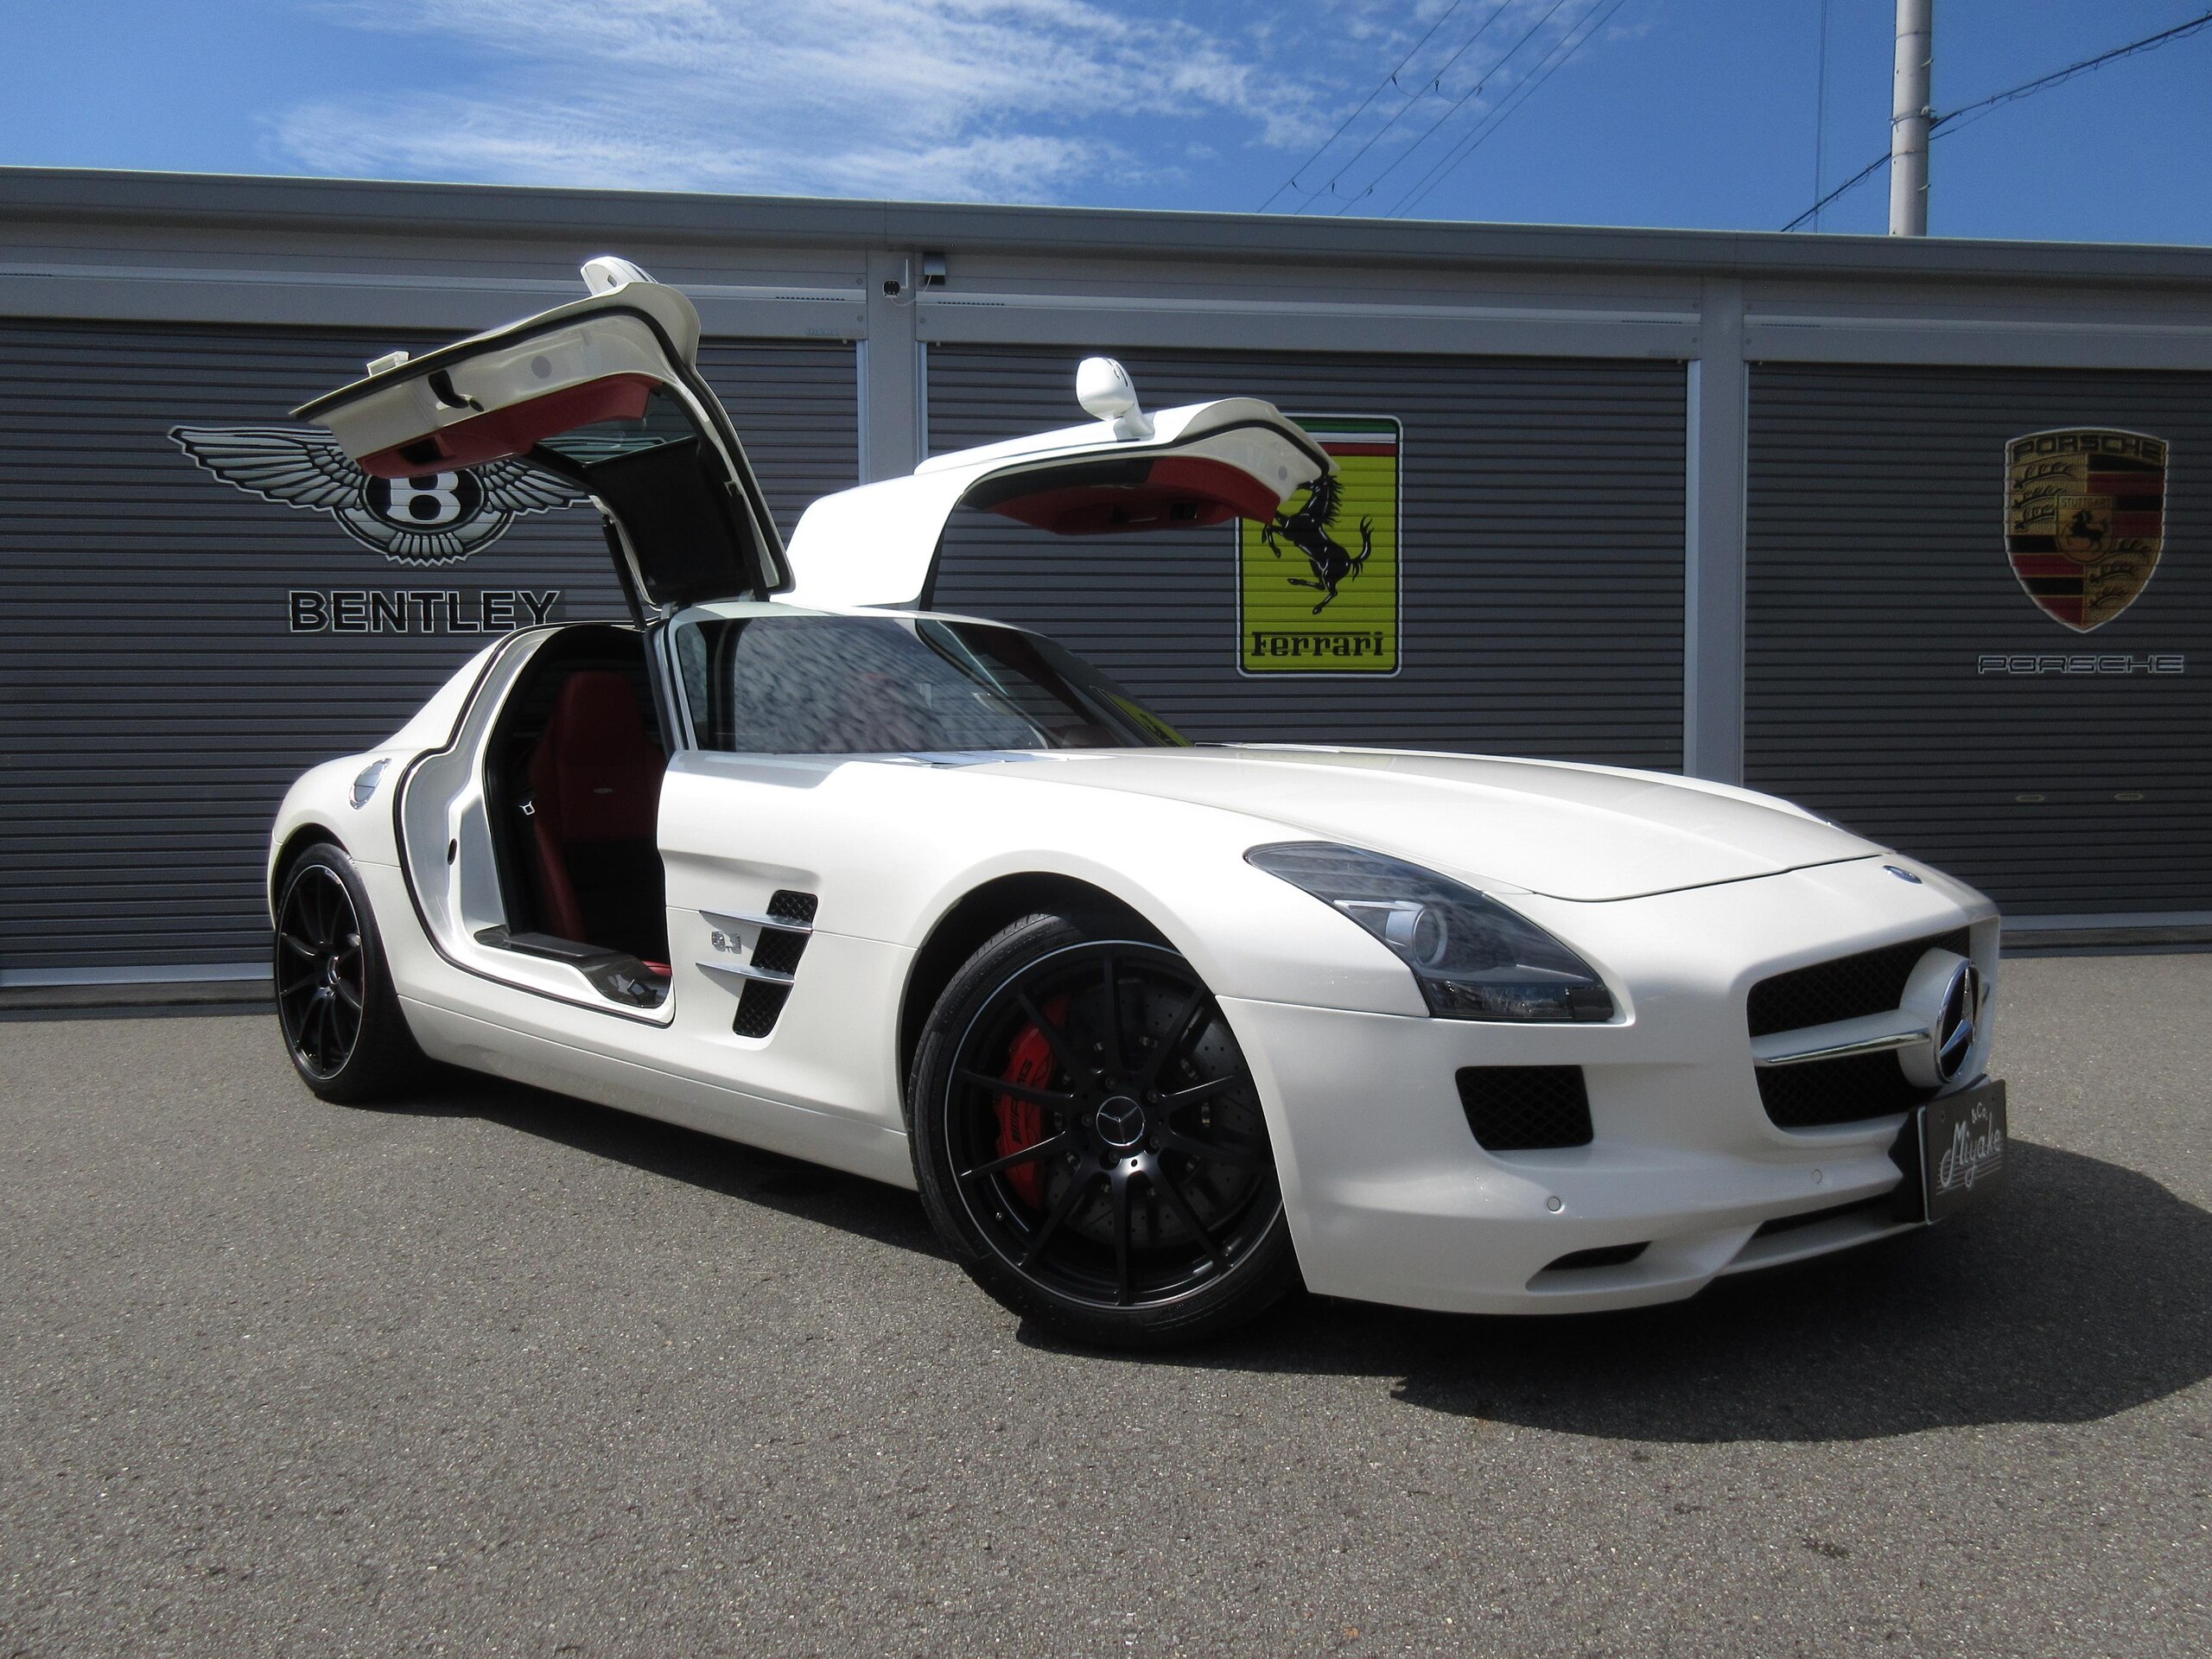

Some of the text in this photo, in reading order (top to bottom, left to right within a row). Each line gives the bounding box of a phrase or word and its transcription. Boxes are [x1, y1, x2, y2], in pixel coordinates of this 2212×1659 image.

[2013, 435, 2160, 462] PORSCHE
[386, 471, 461, 524] B
[288, 590, 560, 633] BENTLEY
[1251, 632, 1383, 656] Ferrari
[1978, 655, 2184, 674] PORSCHE
[1940, 1111, 2000, 1188] Miyake
